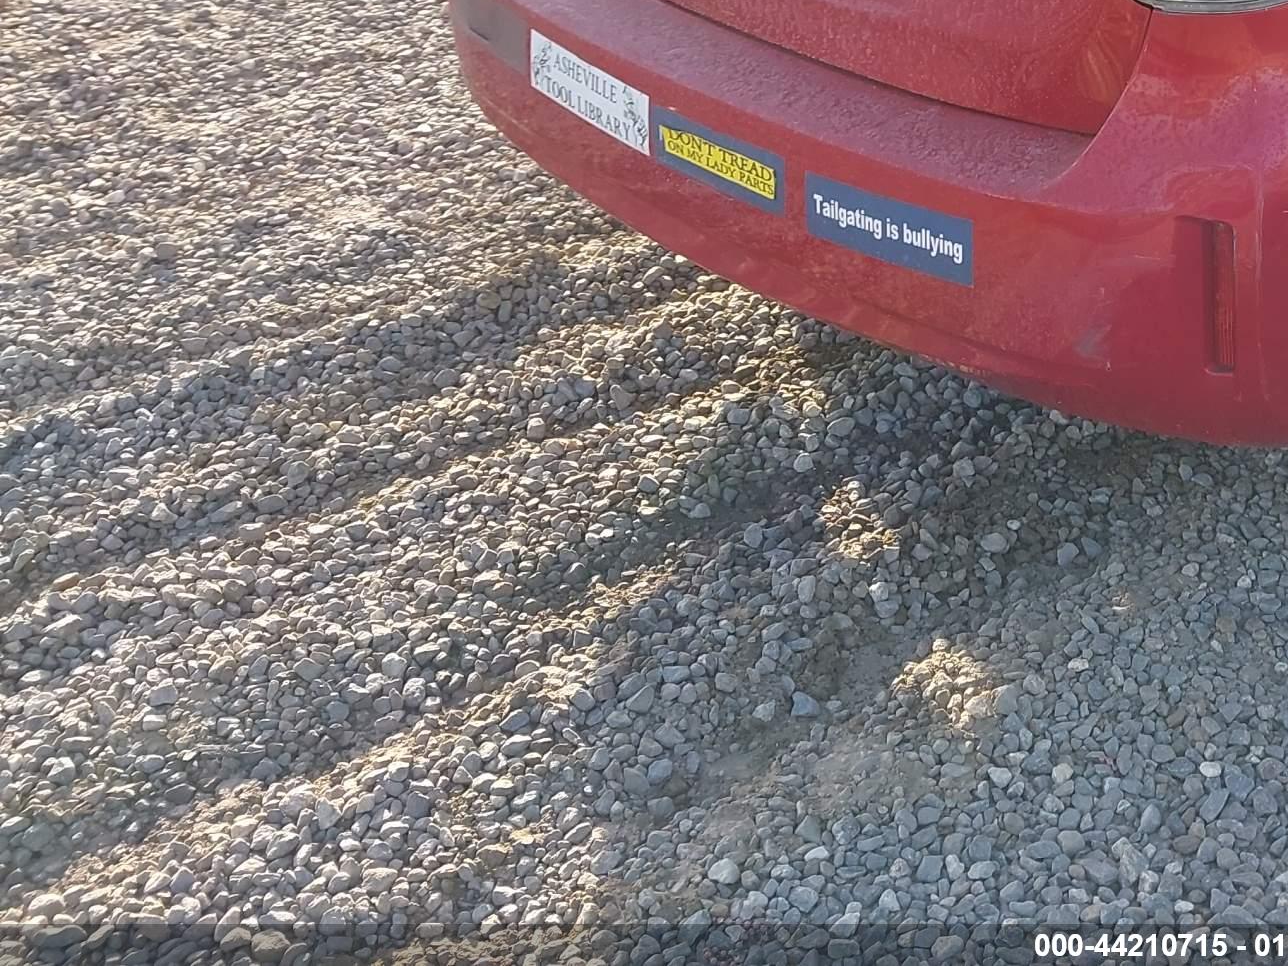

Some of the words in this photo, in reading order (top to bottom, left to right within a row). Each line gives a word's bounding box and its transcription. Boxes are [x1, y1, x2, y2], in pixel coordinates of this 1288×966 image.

[553, 54, 617, 104] ASHEVILLE
[544, 75, 575, 108] TOOL
[578, 96, 631, 141] LIBRARY
[668, 140, 684, 155] ON
[686, 148, 702, 164] MY
[706, 159, 735, 178] LADY
[739, 172, 774, 195] PARTS
[719, 148, 772, 182] TREAD
[813, 193, 882, 240] Tailgating
[886, 218, 899, 240] is
[903, 223, 963, 264] bullying
